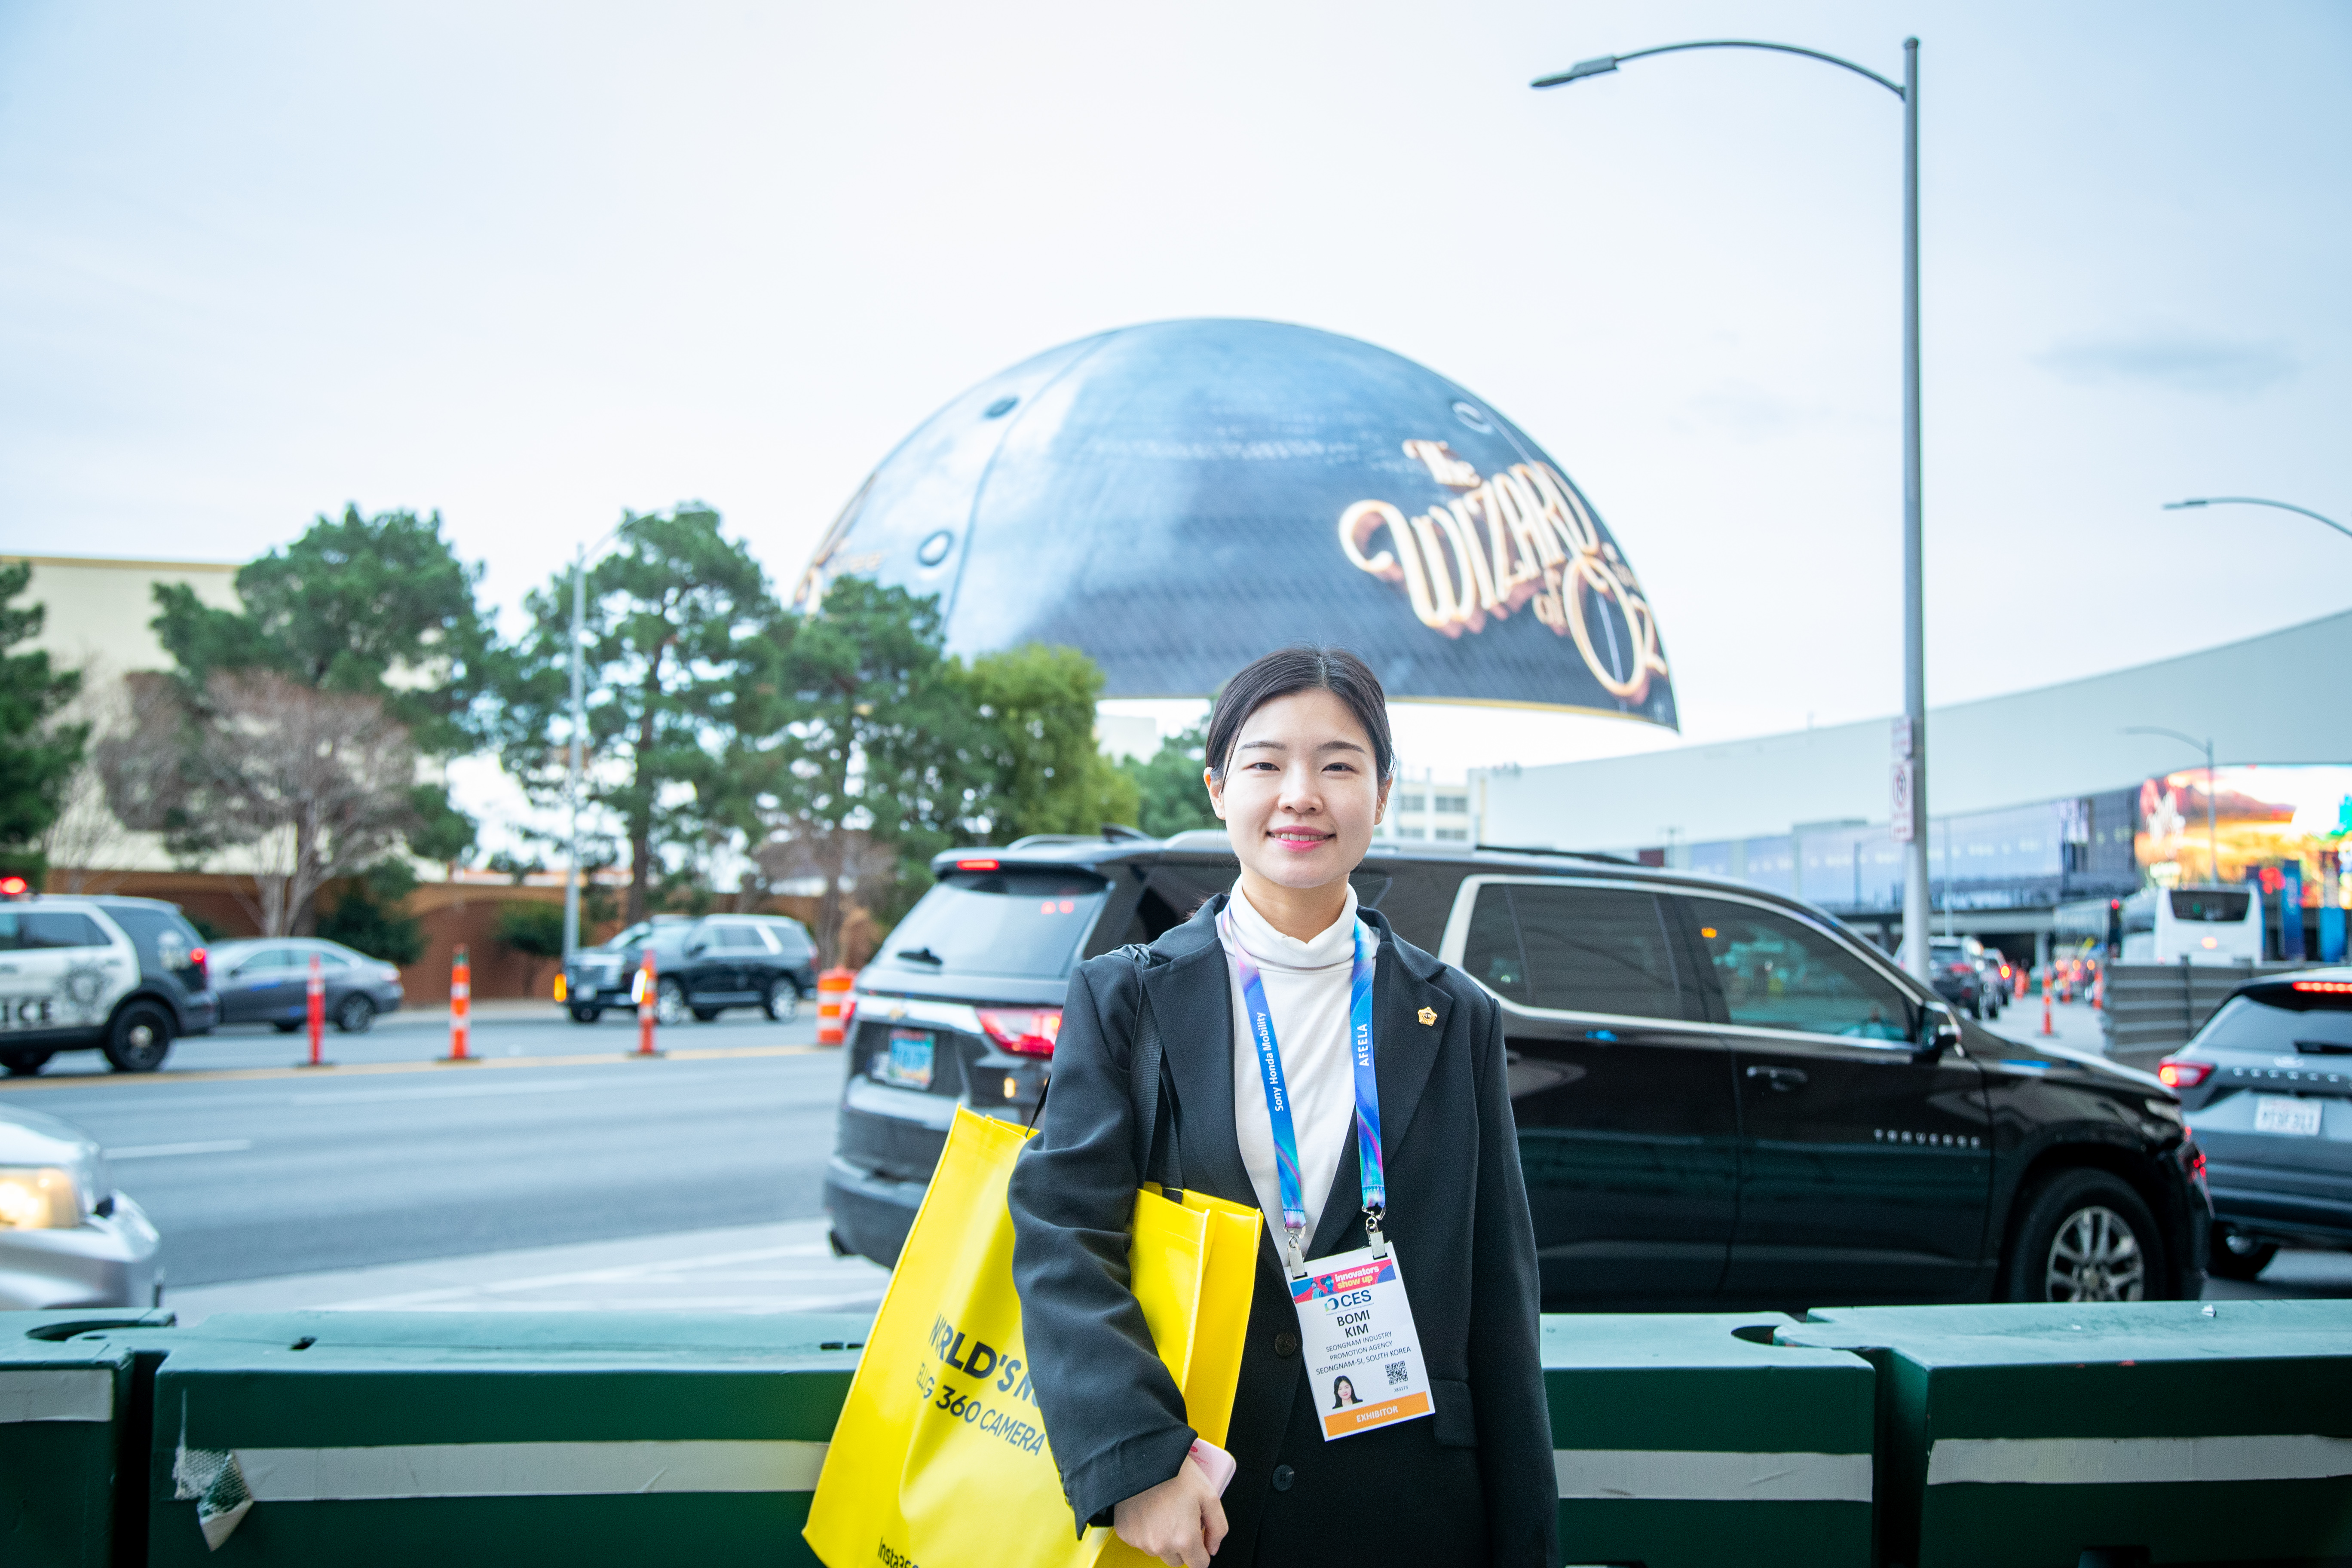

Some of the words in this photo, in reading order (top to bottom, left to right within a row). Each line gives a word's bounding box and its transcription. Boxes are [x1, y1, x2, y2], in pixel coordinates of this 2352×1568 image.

[1257, 1012, 1271, 1051] Mobility
[1357, 1023, 1369, 1066] AFEELA
[1265, 1053, 1278, 1084] Honda
[1273, 1087, 1283, 1112] Sony
[1335, 1266, 1379, 1282] innovators
[1337, 1278, 1360, 1289] show
[1362, 1275, 1373, 1283] up
[1341, 1290, 1372, 1307] CES
[1337, 1310, 1370, 1327] BOMI
[1344, 1323, 1369, 1338] KIM
[1326, 1339, 1362, 1353] SEONGNAM
[1363, 1331, 1392, 1343] INDUSTRY
[1329, 1347, 1367, 1361] PROMOTION
[1369, 1341, 1392, 1353] AGENCY
[1316, 1358, 1365, 1375] SEONGNAM-SI,
[1366, 1352, 1388, 1363] SOUTH
[1390, 1346, 1412, 1357] KOREA
[936, 1384, 981, 1423] 360
[980, 1409, 1045, 1456] CAMERA
[1356, 1406, 1398, 1423] EXHIBITOR
